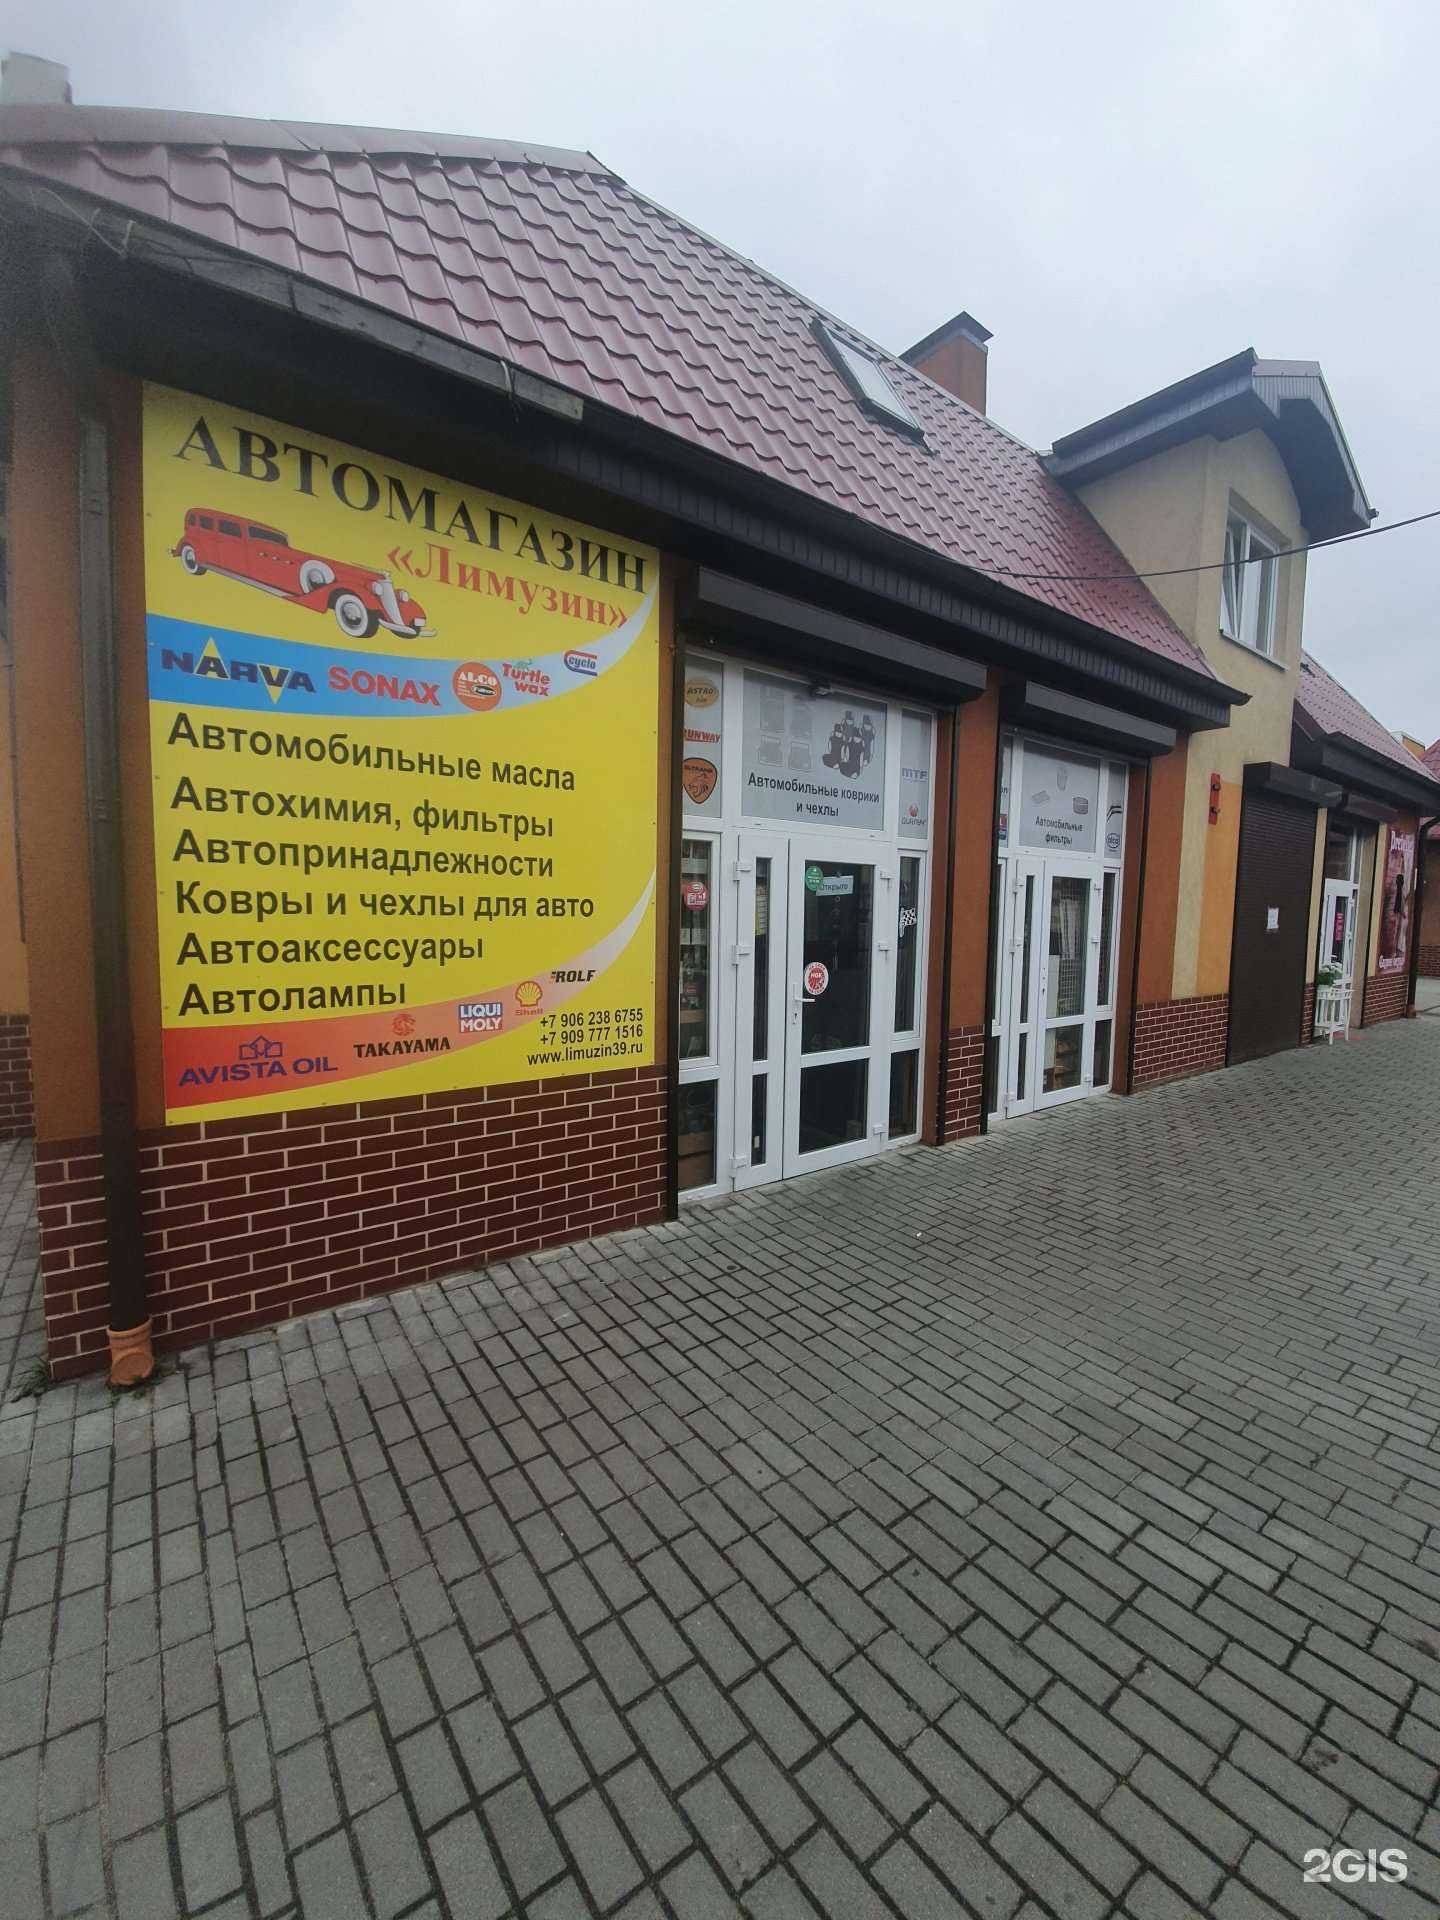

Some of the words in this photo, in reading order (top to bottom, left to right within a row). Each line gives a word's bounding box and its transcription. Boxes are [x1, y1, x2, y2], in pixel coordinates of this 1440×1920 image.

[174, 416, 648, 595] АВТОМАГАЗИН
[387, 543, 628, 629] «Лимузин»
[161, 646, 317, 696] NARVA
[458, 671, 498, 687] ALCO
[502, 663, 550, 685] Turtle
[328, 665, 441, 706] SONAX
[515, 681, 549, 696] wax
[168, 713, 482, 780] Автомобильные
[491, 759, 575, 791] масла
[747, 772, 838, 798] Автомобильные
[841, 789, 880, 804] коврики
[171, 777, 402, 831] Автохимия,
[413, 799, 554, 843] фильтры
[796, 802, 803, 813] и
[806, 804, 839, 817] чехлы
[1035, 815, 1083, 832] Автомобильные
[1045, 833, 1073, 845] фильтры
[173, 829, 554, 878] Автопринадлежности
[176, 881, 312, 922] Ковры
[326, 892, 346, 915] и
[360, 893, 464, 917] чехлы
[474, 894, 526, 921] для
[536, 895, 594, 917] авто
[176, 932, 483, 969] Автоаксессуары
[556, 970, 596, 983] ROLF
[178, 981, 405, 1016] Автолампы
[460, 1003, 502, 1017] LIQUI
[460, 1017, 502, 1032] MOLY
[540, 1015, 556, 1028] +7
[561, 1013, 584, 1027] 906
[589, 1011, 610, 1025] 238
[615, 1008, 643, 1023] 6755
[540, 1032, 556, 1045] +7
[561, 1030, 584, 1044] 909
[589, 1027, 610, 1041] 777
[615, 1024, 643, 1039] 1516
[353, 1037, 451, 1058] TAKAYAMA
[527, 1042, 643, 1065] www.limuzin39.ru
[179, 1061, 287, 1086] AVISTA
[292, 1057, 338, 1074] OIL
